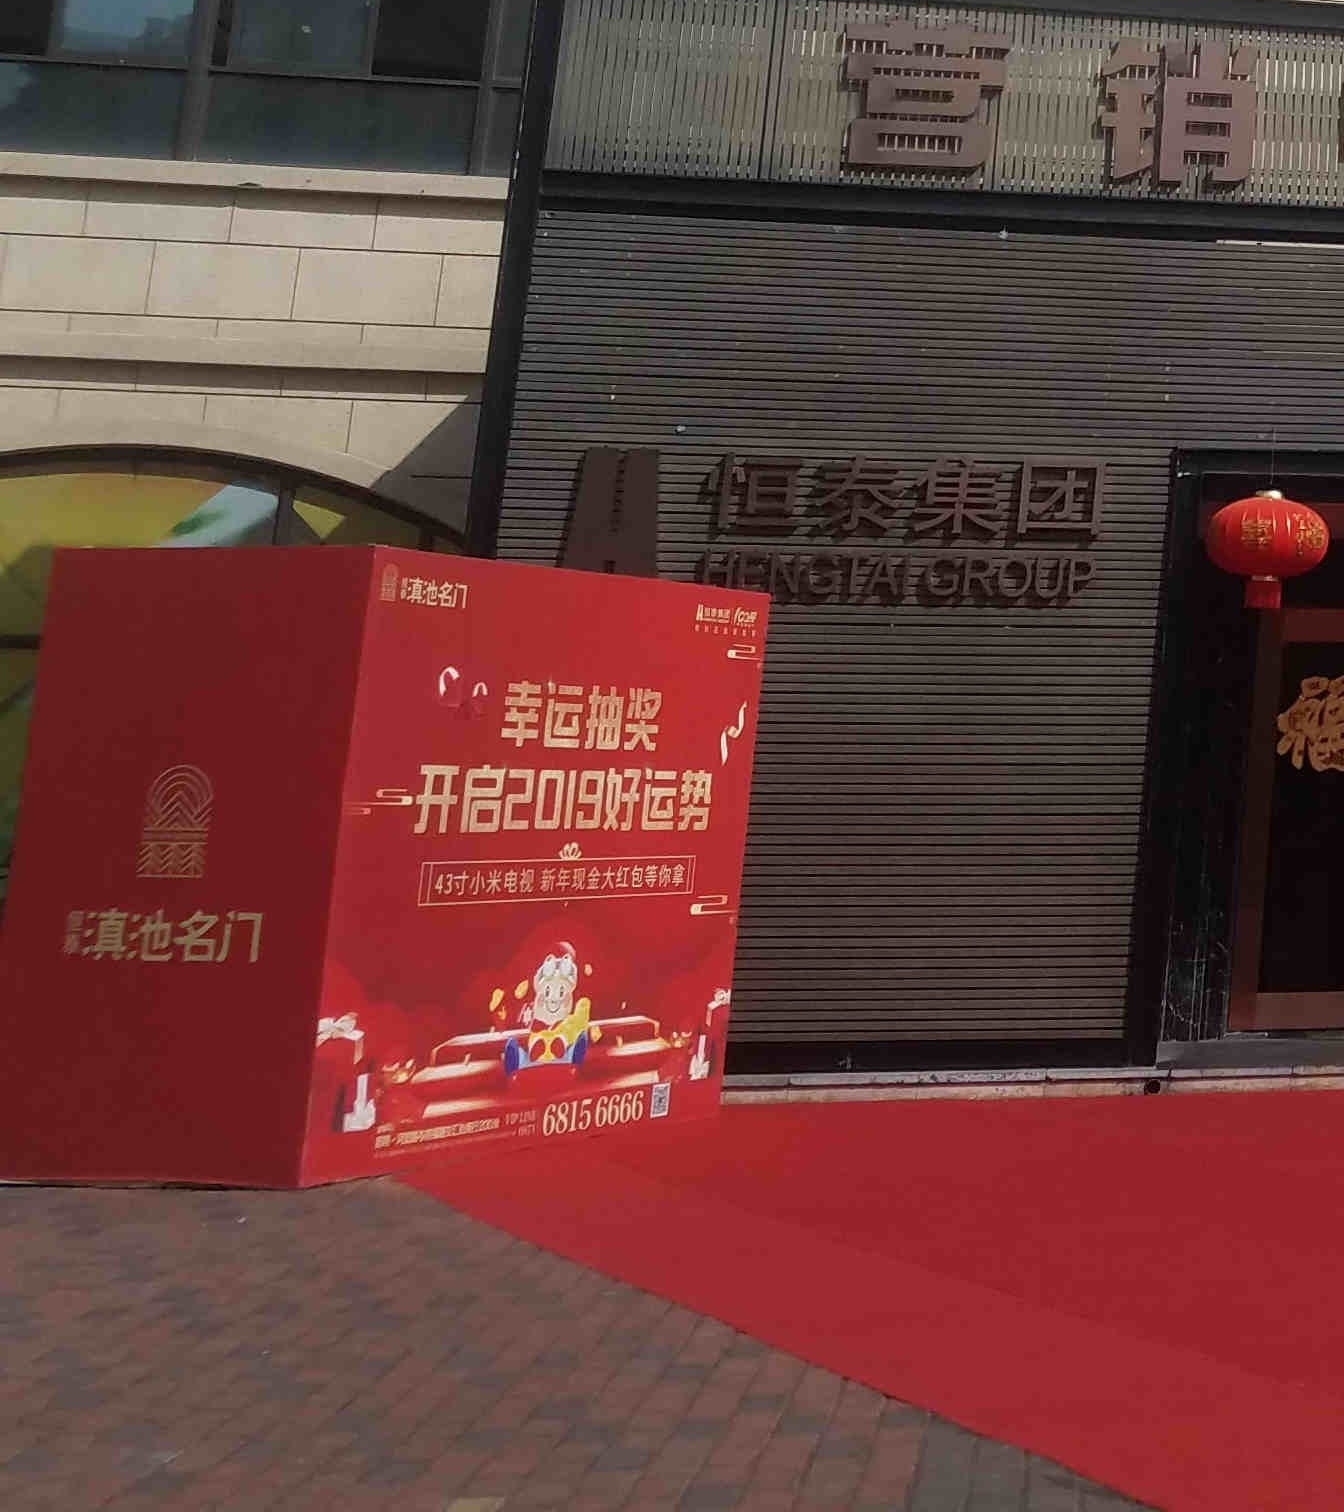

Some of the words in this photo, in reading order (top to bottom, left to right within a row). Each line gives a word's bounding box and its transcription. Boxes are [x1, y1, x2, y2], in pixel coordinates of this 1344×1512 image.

[705, 454, 1101, 537] 恒泰集团
[407, 577, 467, 609] 滇池名门
[703, 549, 911, 596] HENGTAI
[927, 553, 1098, 599] GROUP
[501, 680, 663, 751] 幸运抽奖
[413, 765, 713, 834] 开启2019好运势
[83, 911, 264, 963] 滇池名门
